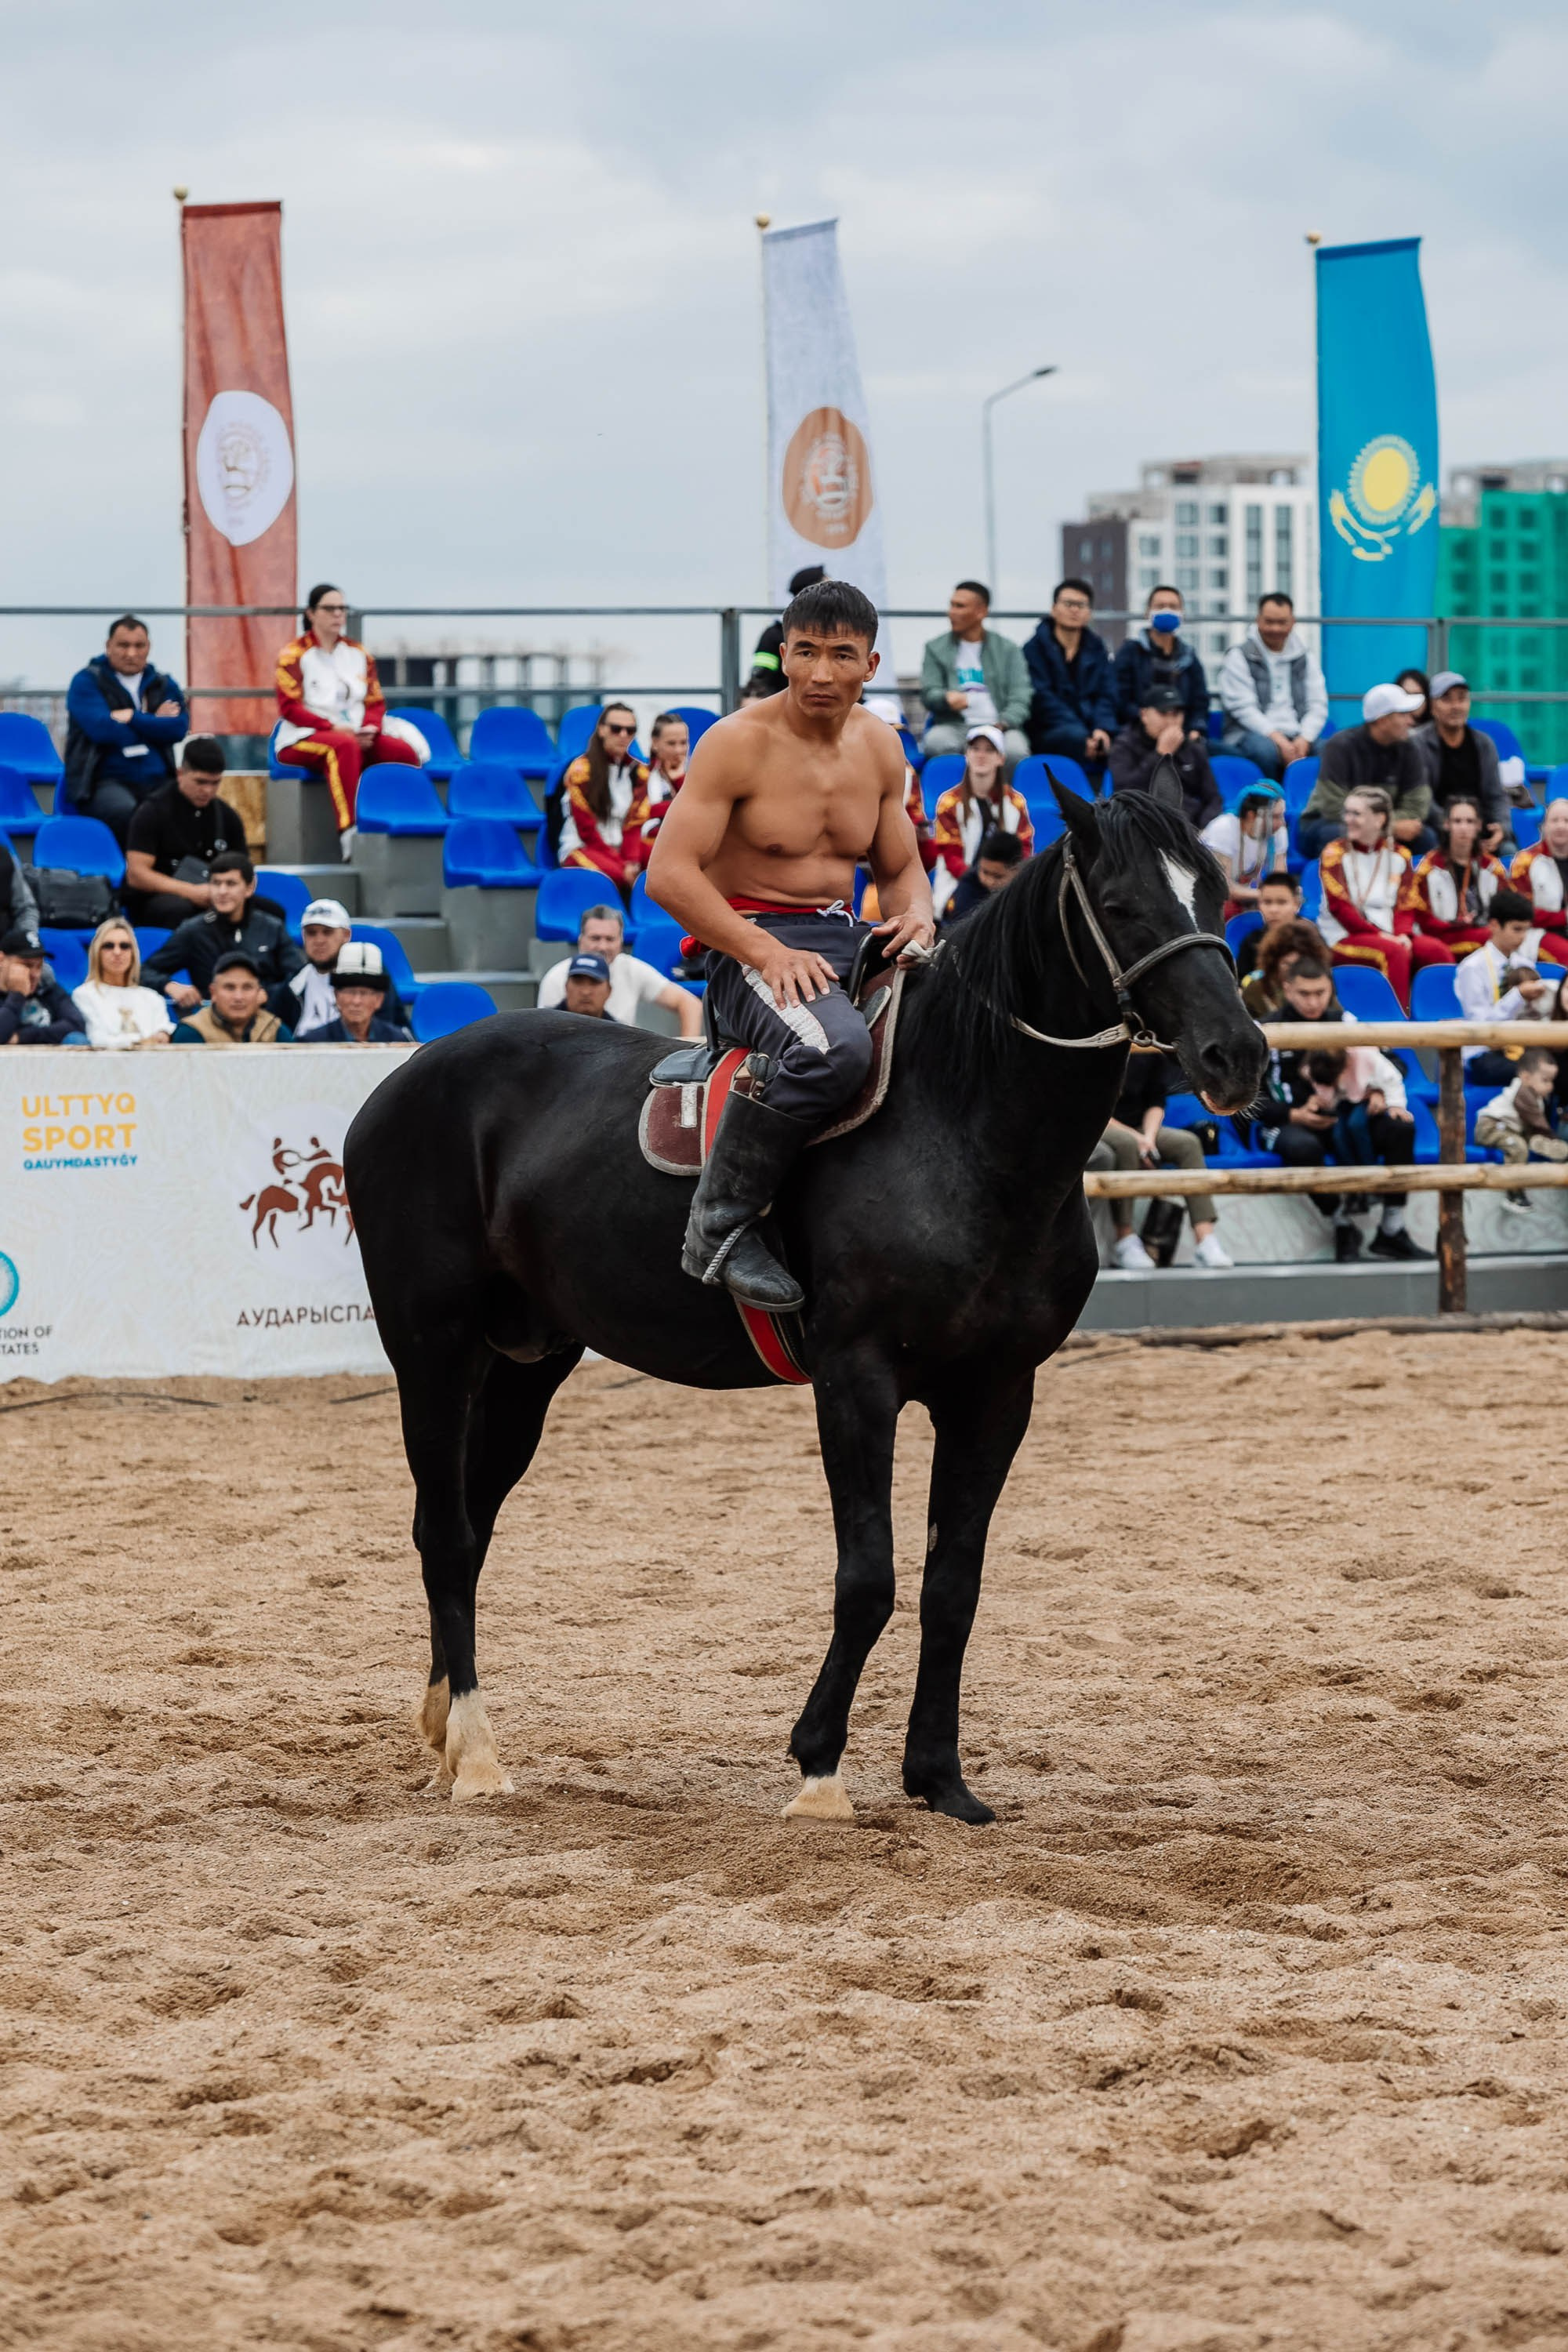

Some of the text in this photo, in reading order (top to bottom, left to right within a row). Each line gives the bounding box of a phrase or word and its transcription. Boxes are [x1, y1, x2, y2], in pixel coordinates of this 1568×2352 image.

[21, 1092, 136, 1118] ULTTYQ
[22, 1123, 137, 1152] SPORT
[34, 1324, 53, 1339] OF
[0, 1341, 39, 1356] TATES
